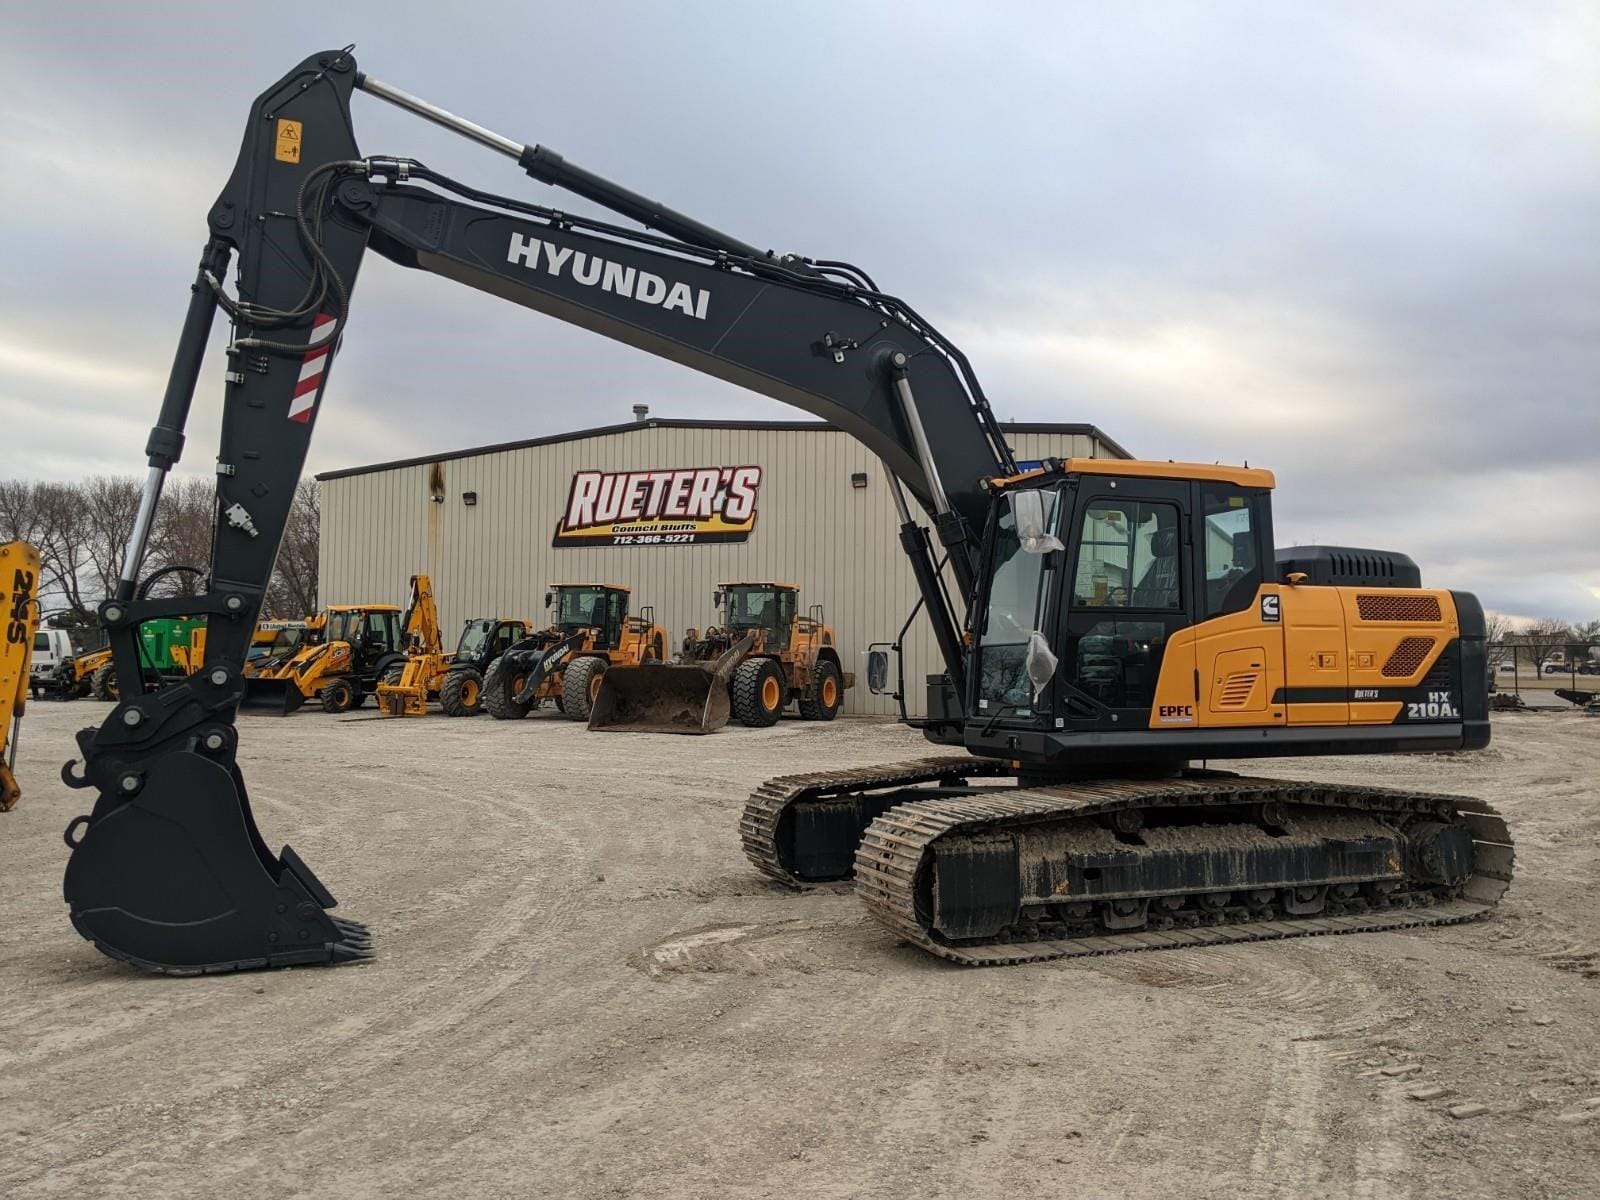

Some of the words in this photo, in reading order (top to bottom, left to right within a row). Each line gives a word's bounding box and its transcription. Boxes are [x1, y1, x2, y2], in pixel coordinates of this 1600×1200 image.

[507, 232, 710, 320] HYUNDAI
[567, 467, 761, 528] RUETER'S
[612, 525, 658, 533] Council
[660, 523, 696, 531] Bluffs
[613, 534, 695, 545] 712-366-5221
[1428, 691, 1449, 702] HX
[1159, 705, 1193, 717] EPFC
